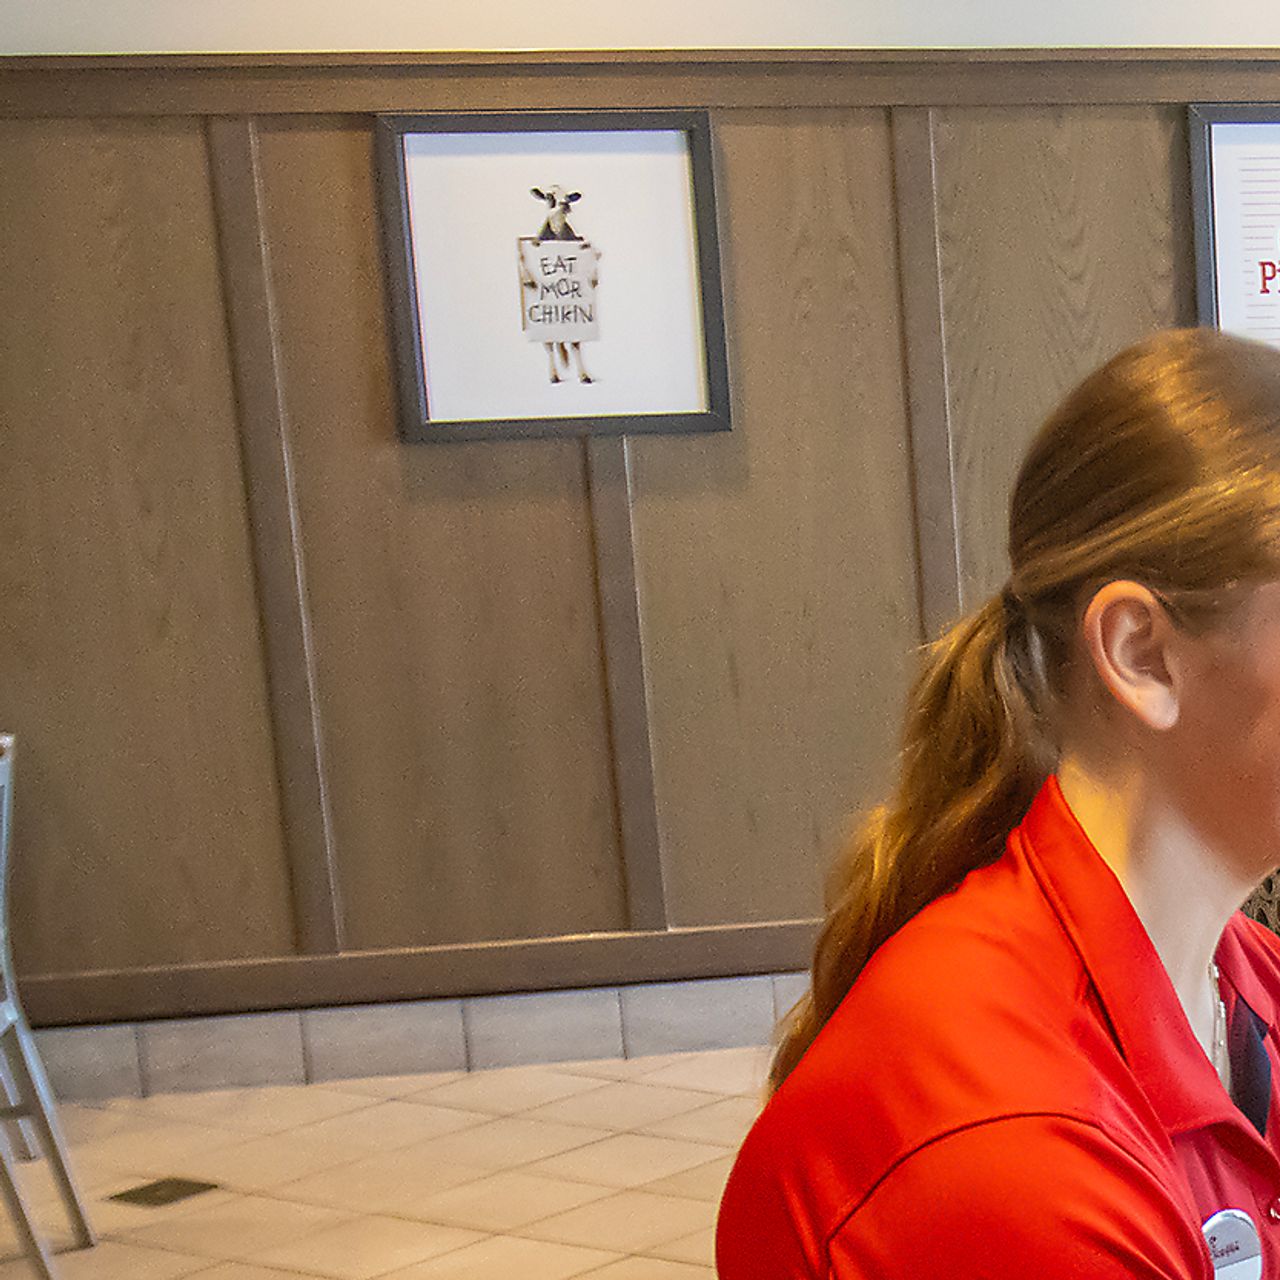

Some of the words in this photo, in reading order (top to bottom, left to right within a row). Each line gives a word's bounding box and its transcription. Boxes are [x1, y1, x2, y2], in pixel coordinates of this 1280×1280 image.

[539, 255, 577, 276] EAT
[540, 278, 582, 300] MOR
[528, 304, 594, 325] CHIKIN
